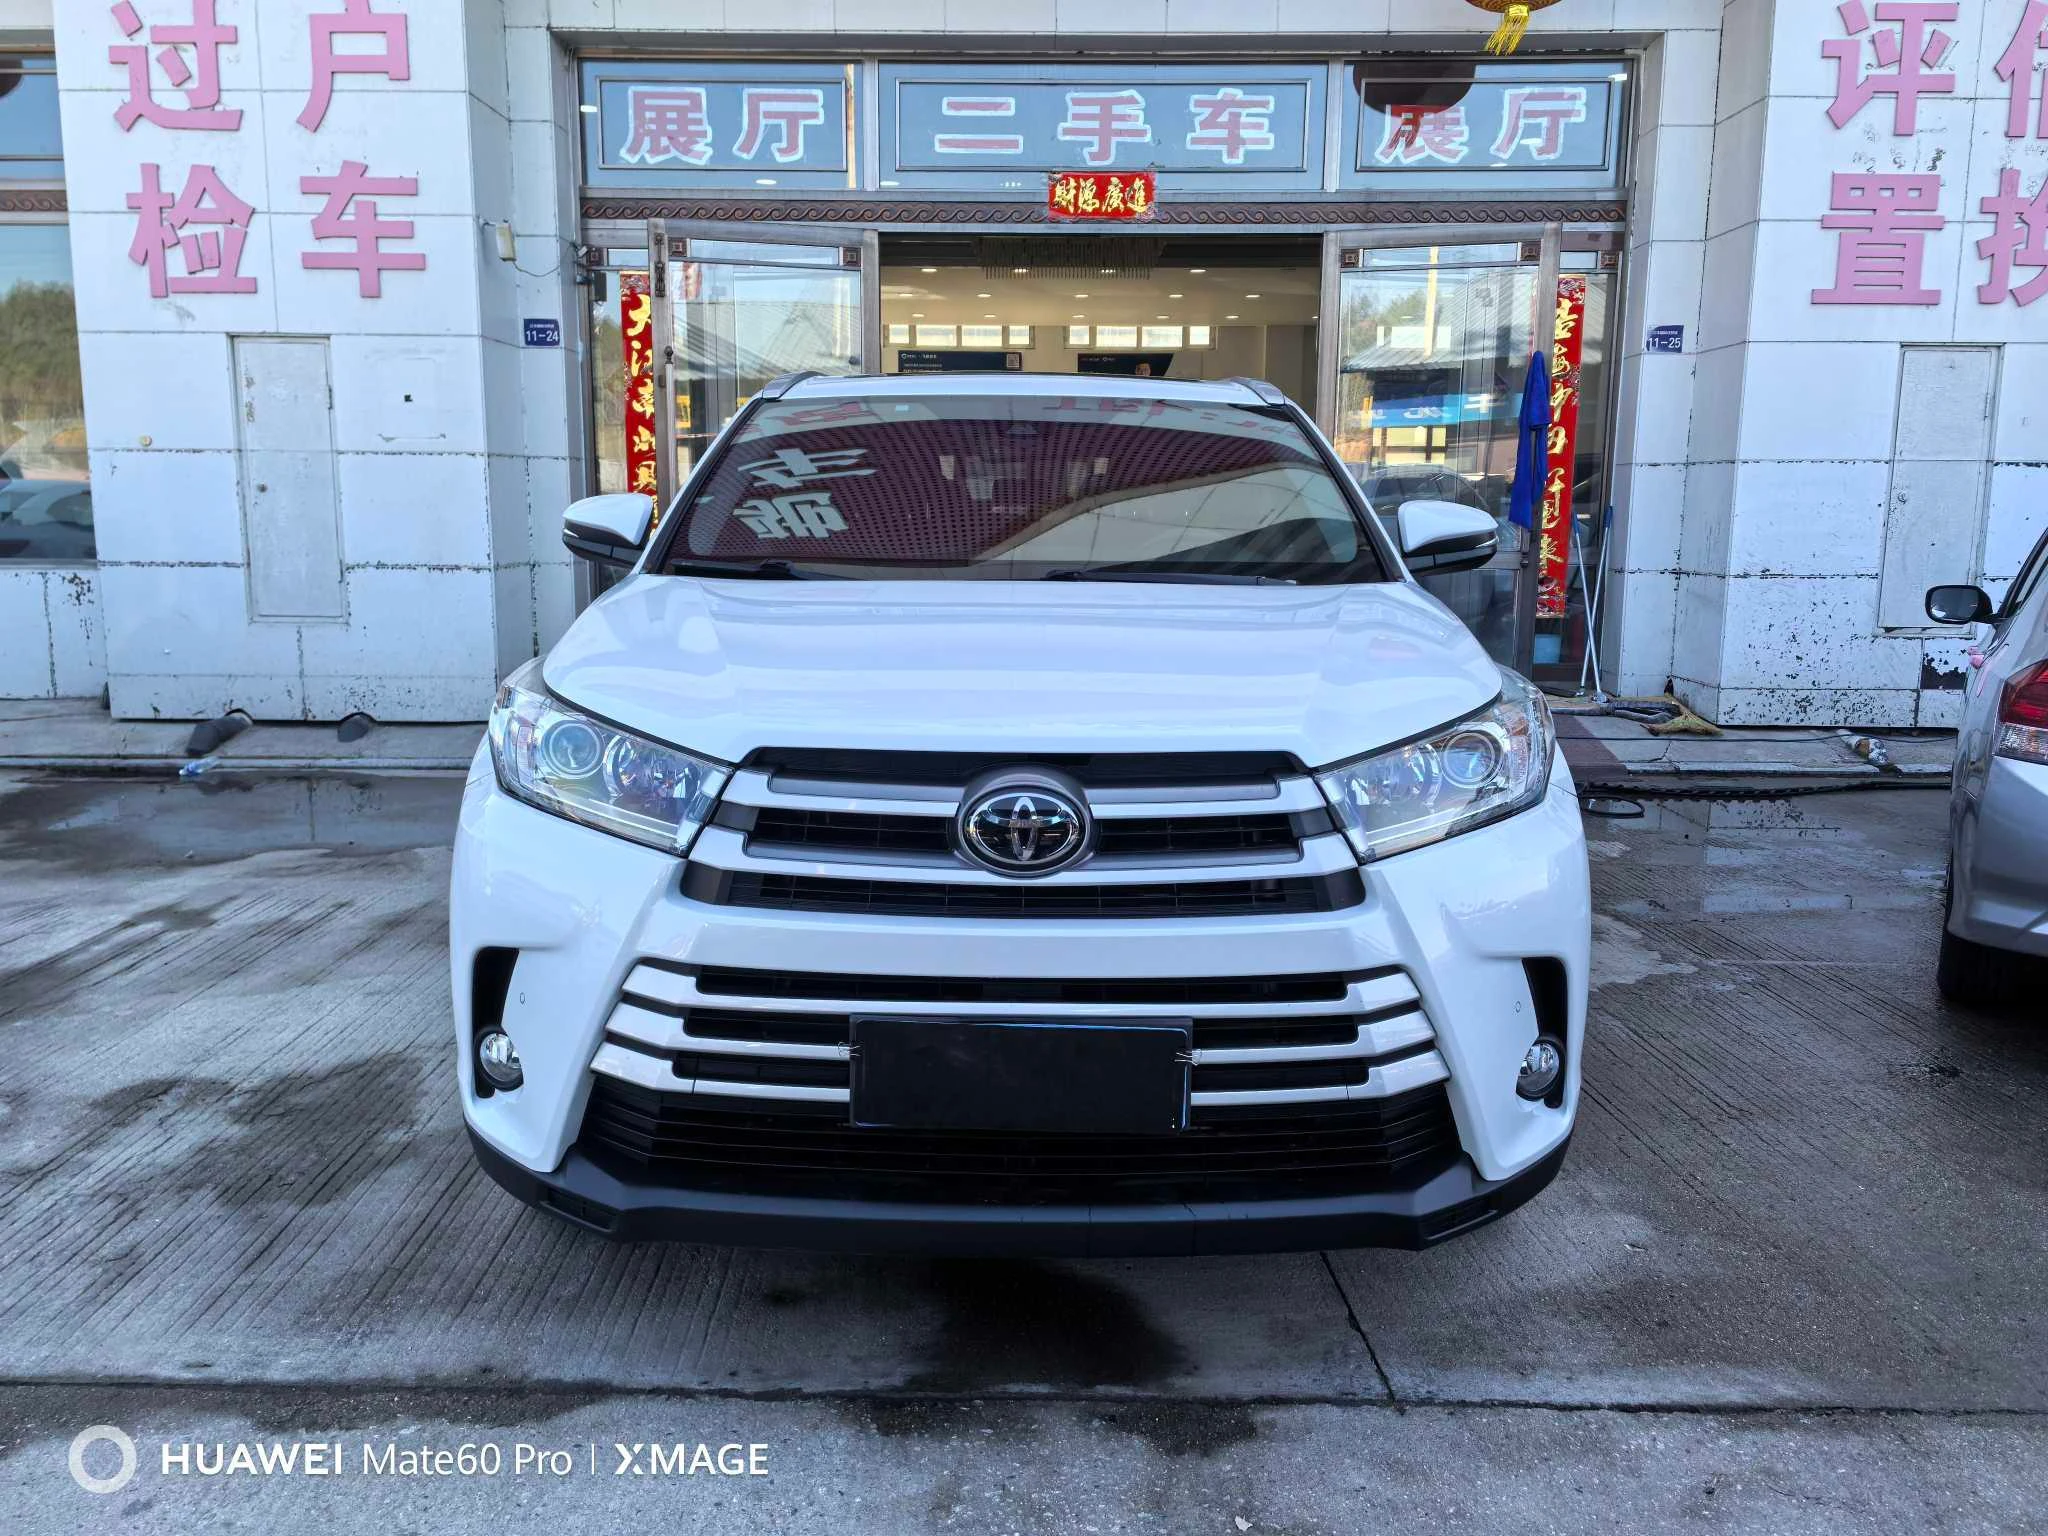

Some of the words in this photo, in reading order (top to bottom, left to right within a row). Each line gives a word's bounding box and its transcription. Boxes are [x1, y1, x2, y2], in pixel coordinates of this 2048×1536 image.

[108, 0, 411, 133] 过户
[620, 85, 825, 165] 展厅
[935, 88, 1275, 166] 二手车
[126, 160, 427, 299] 检车
[526, 330, 559, 342] 11-24
[1648, 337, 1681, 349] 11-25
